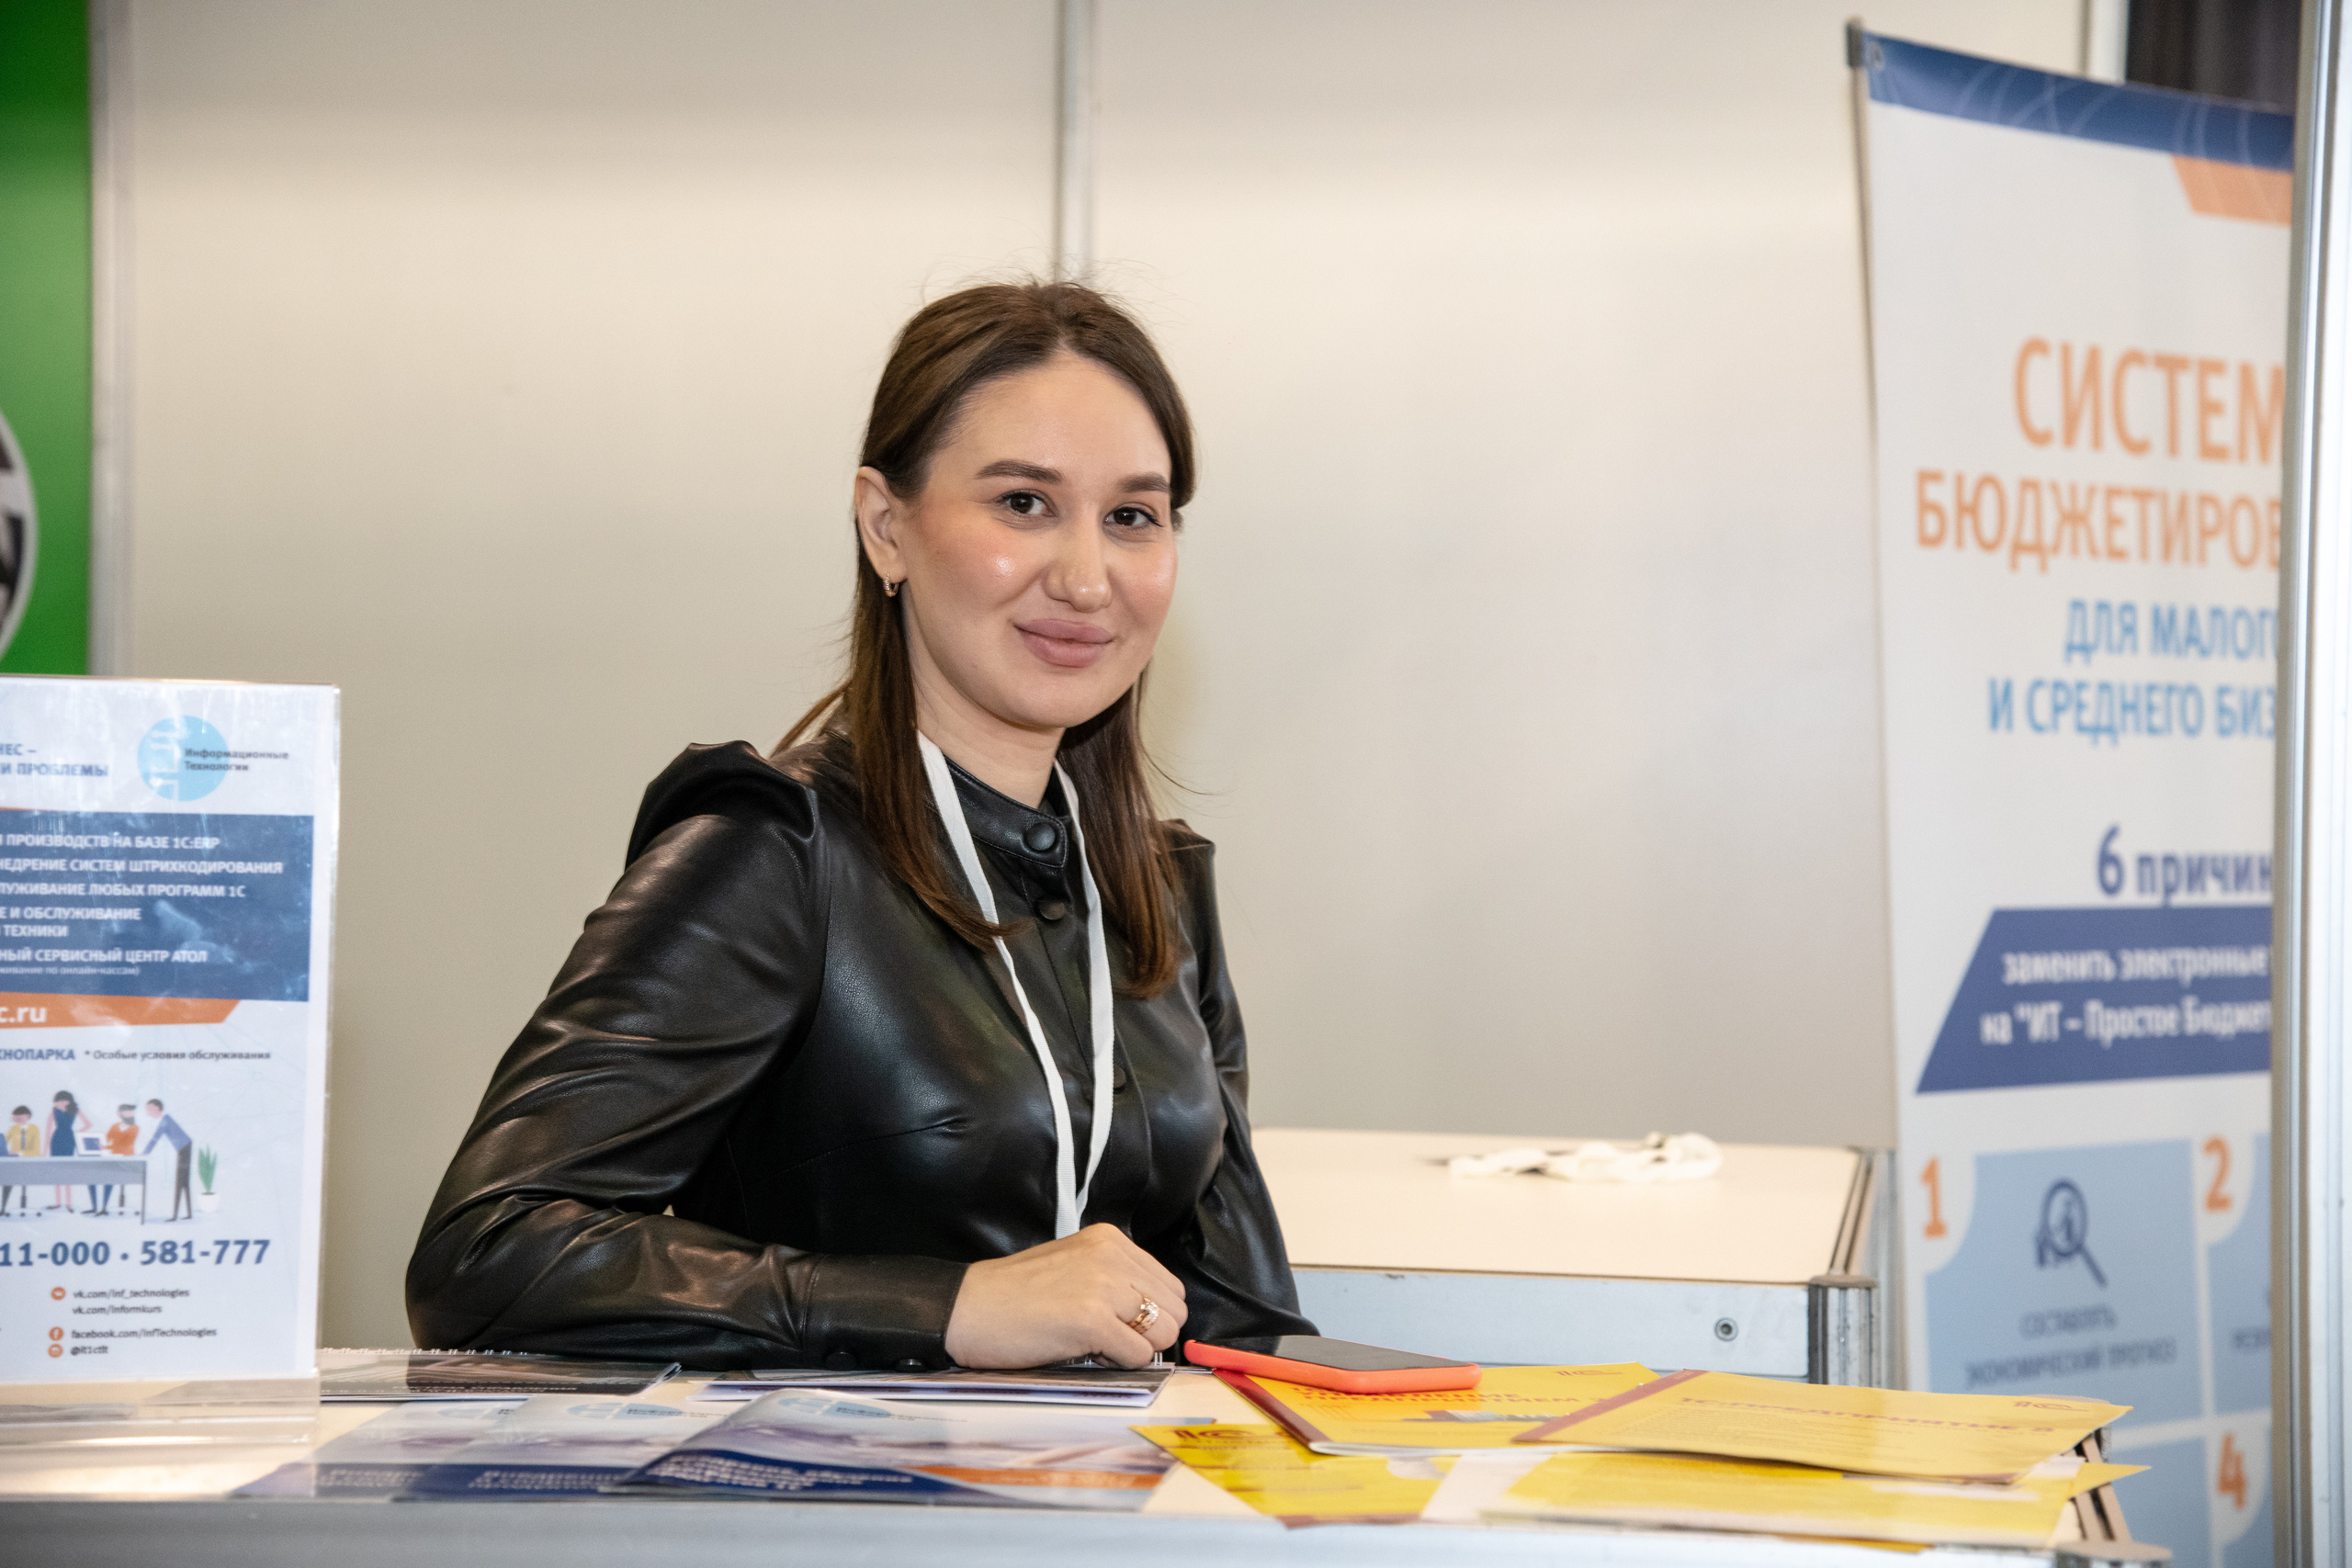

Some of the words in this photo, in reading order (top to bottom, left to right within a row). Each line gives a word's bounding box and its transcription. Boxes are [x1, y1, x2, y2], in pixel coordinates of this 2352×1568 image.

[2013, 336, 2286, 468] СИСТЕМ
[2064, 599, 2138, 666] ДЛЯ
[2151, 604, 2278, 660] МАЛОГ
[1988, 677, 2014, 732] И
[2026, 677, 2204, 748] СРЕДНЕГО
[185, 748, 288, 761] Информационные
[17, 762, 109, 776] ПРОБЛЕМЫ
[185, 761, 249, 772] Технологии
[6, 833, 109, 850] ПРОИЗВОДСТВ
[113, 834, 131, 848] НА
[135, 835, 169, 849] БАЗЕ
[70, 859, 126, 873] СИСТЕМ
[129, 859, 284, 875] ШТРИХКОДИРОВАНИЯ
[2095, 822, 2125, 897] 6
[88, 883, 145, 897] ЛЮБЫХ
[148, 884, 225, 897] ПРОГРАММ
[229, 885, 246, 898] 1С
[23, 907, 141, 920] ОБСЛУЖИВАНИЕ
[3, 924, 69, 937] ТЕХНИКИ
[35, 946, 122, 963] СЕРВИСНЫЙ
[125, 949, 169, 964] ЦЕНТР
[171, 950, 209, 963] АТОЛ
[94, 1049, 137, 1060] Особые
[141, 1051, 186, 1063] условия
[188, 1048, 271, 1063] обслуживания
[2201, 1134, 2233, 1213] 2
[1920, 1156, 1948, 1239] 1
[140, 1239, 271, 1266] 581-777
[2217, 1431, 2247, 1511] 4
